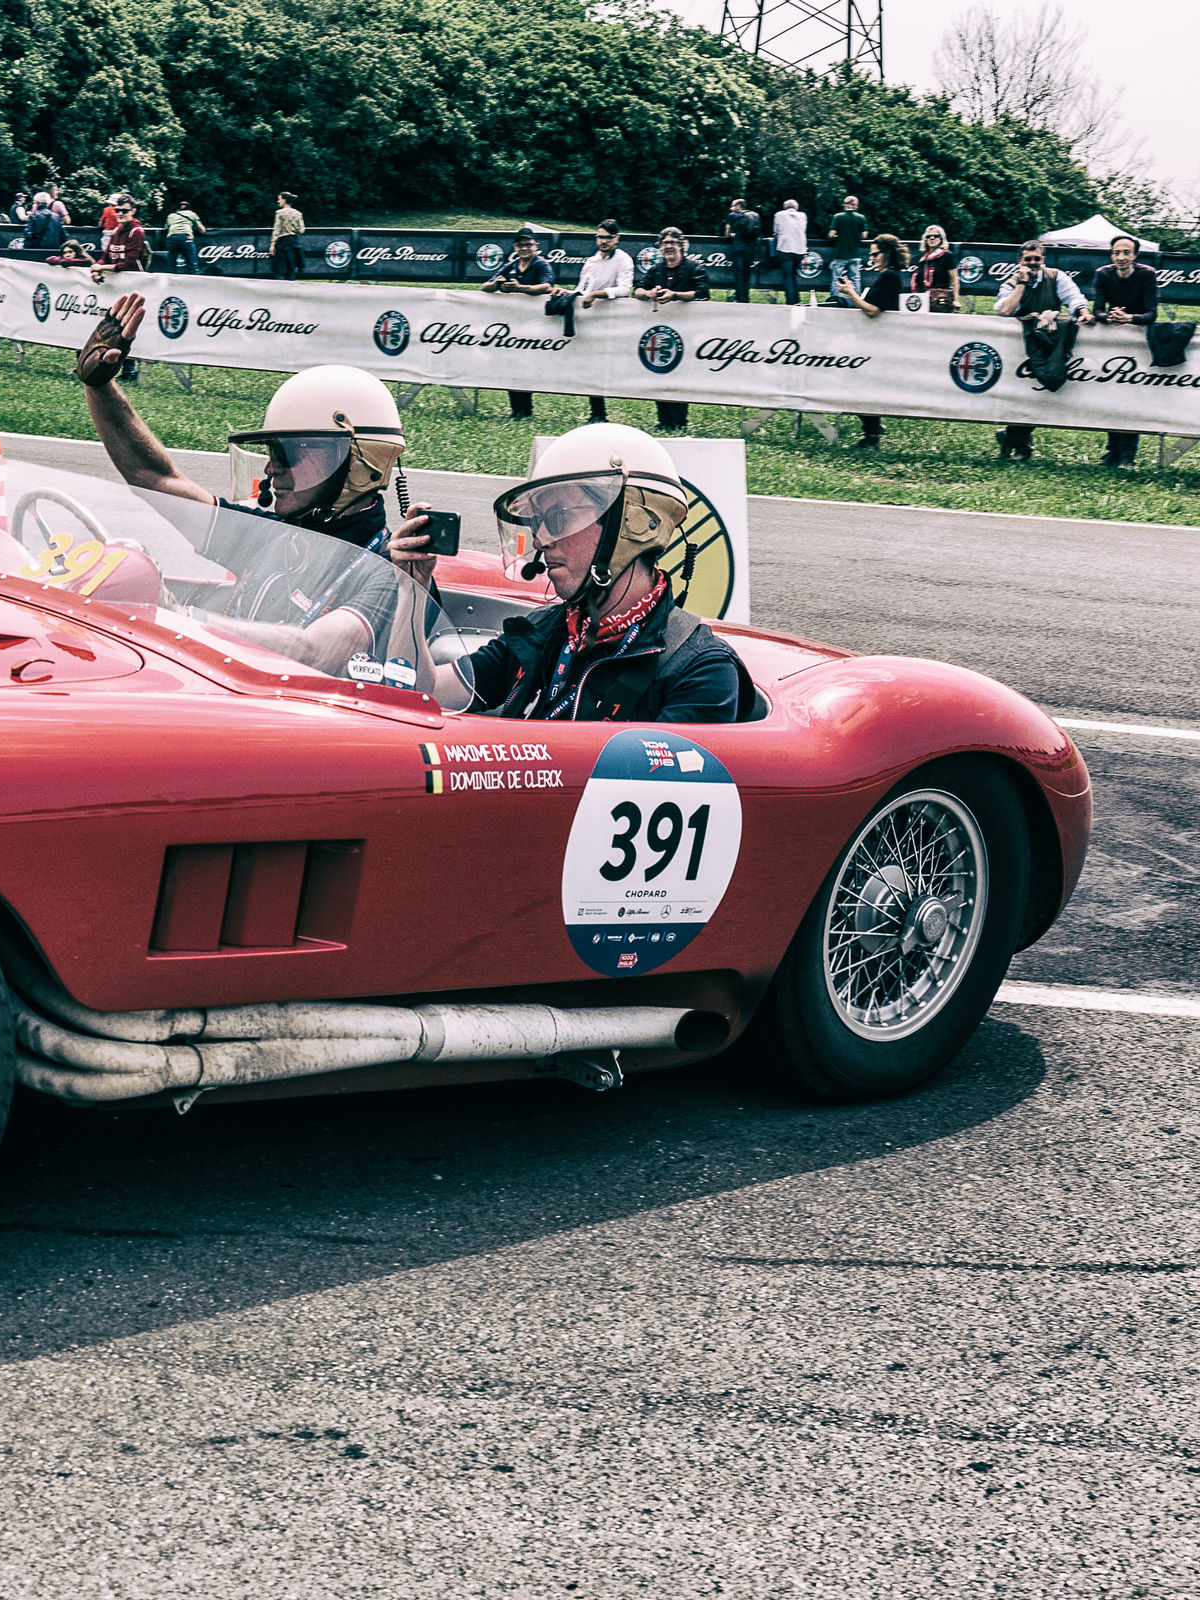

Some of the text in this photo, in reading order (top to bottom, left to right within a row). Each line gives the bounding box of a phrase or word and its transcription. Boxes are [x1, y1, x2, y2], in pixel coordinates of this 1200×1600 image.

[197, 244, 270, 264] Alfa Rom
[356, 246, 398, 265] Alfa
[395, 246, 449, 261] Romeo
[988, 262, 1022, 281] Alf
[54, 293, 82, 321] Alfa
[197, 307, 245, 337] Alfa
[243, 307, 319, 335] Romeo
[419, 322, 572, 354] Alfa Romeo
[695, 337, 872, 371] Alfa Romeo
[20, 533, 128, 597] 391
[443, 744, 493, 763] MAXIME
[492, 744, 510, 761] DE
[645, 750, 674, 758] MIGLIA
[649, 758, 675, 767] 2018
[450, 769, 564, 791] DOMINIEK DE CLERCK
[599, 800, 711, 883] 391
[625, 890, 667, 898] CHOPARD
